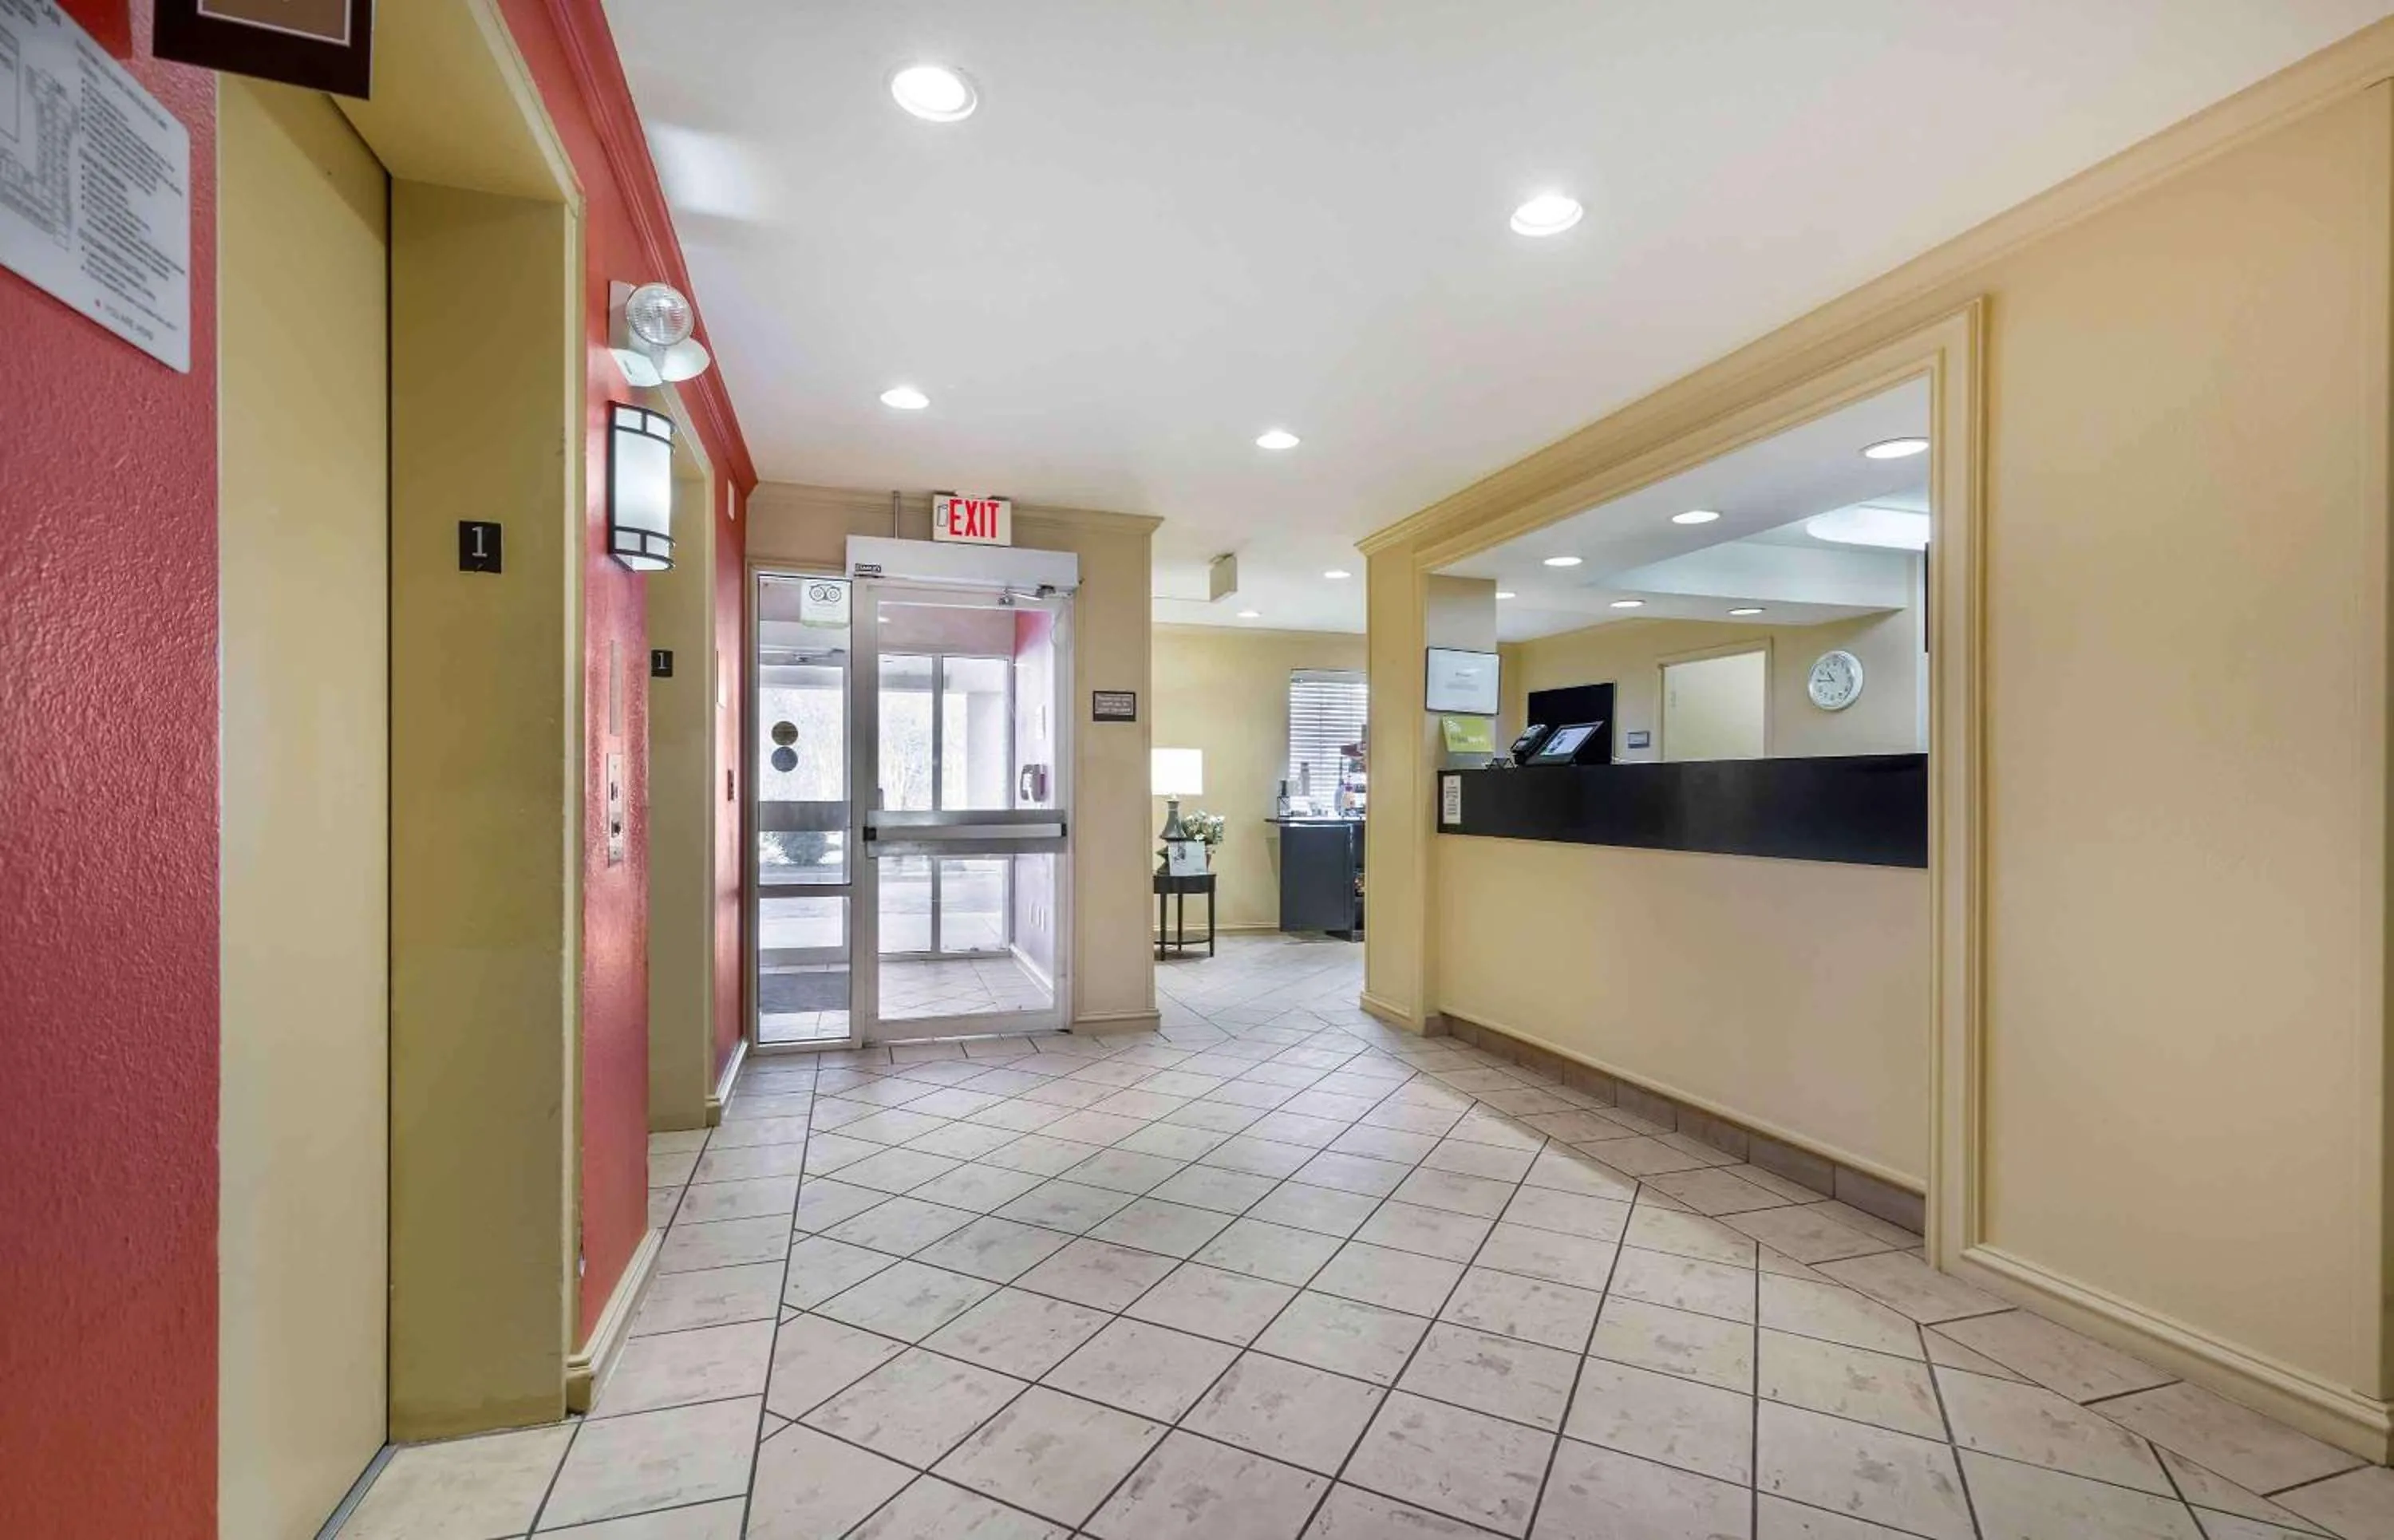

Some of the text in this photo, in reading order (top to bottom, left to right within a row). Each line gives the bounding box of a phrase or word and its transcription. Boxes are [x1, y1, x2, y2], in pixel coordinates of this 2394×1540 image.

[950, 499, 999, 539] EXIT
[472, 526, 488, 558] 1
[657, 652, 668, 669] 1
